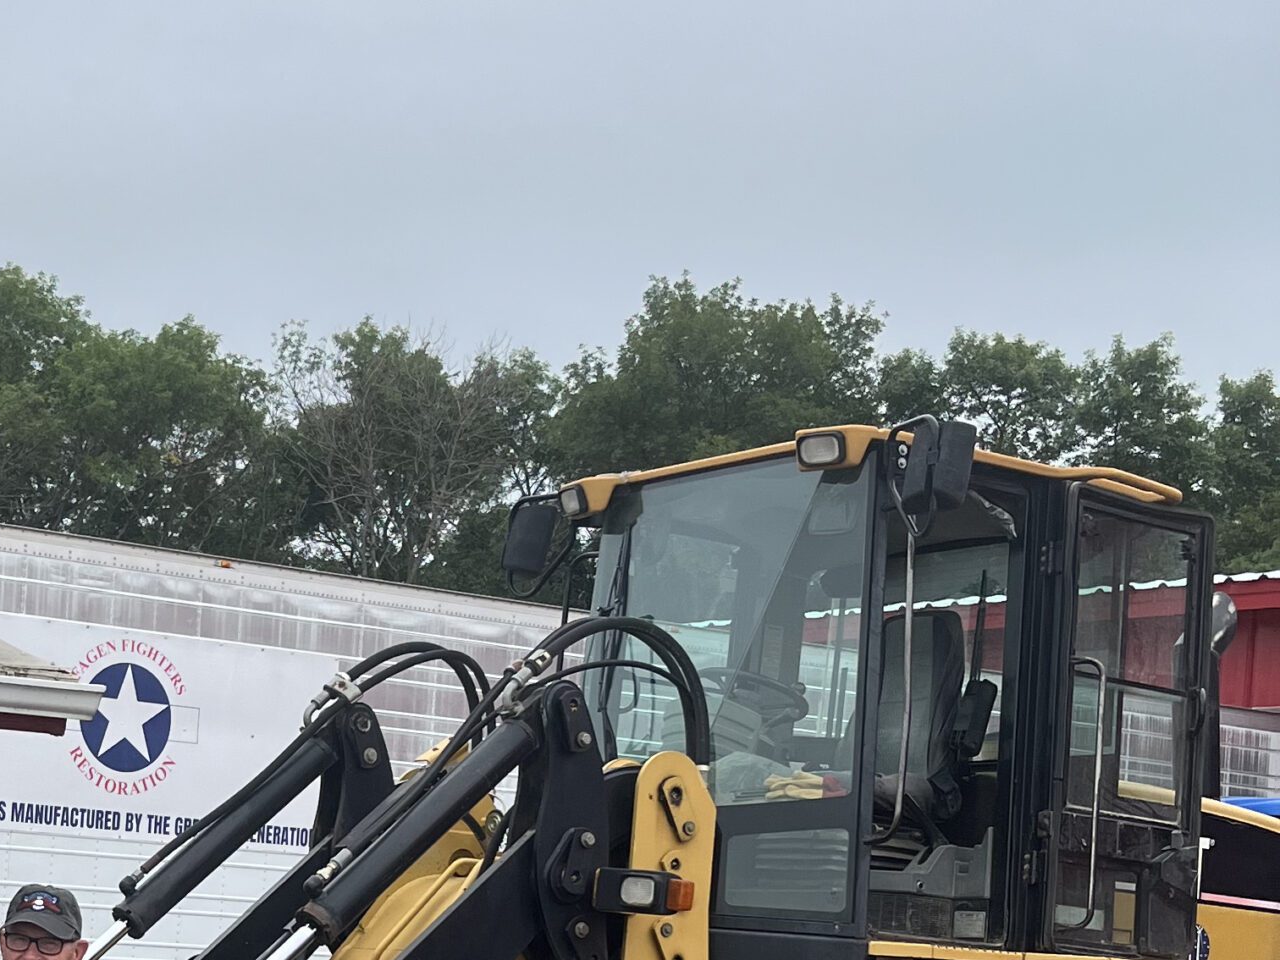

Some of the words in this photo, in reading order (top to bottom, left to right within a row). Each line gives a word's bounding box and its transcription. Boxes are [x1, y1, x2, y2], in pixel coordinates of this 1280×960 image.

[121, 638, 187, 696] FIGHTERS
[70, 745, 177, 796] RESTORATION
[10, 801, 121, 831] MANUFACTURED
[125, 811, 143, 832] BY
[147, 814, 171, 836] THE
